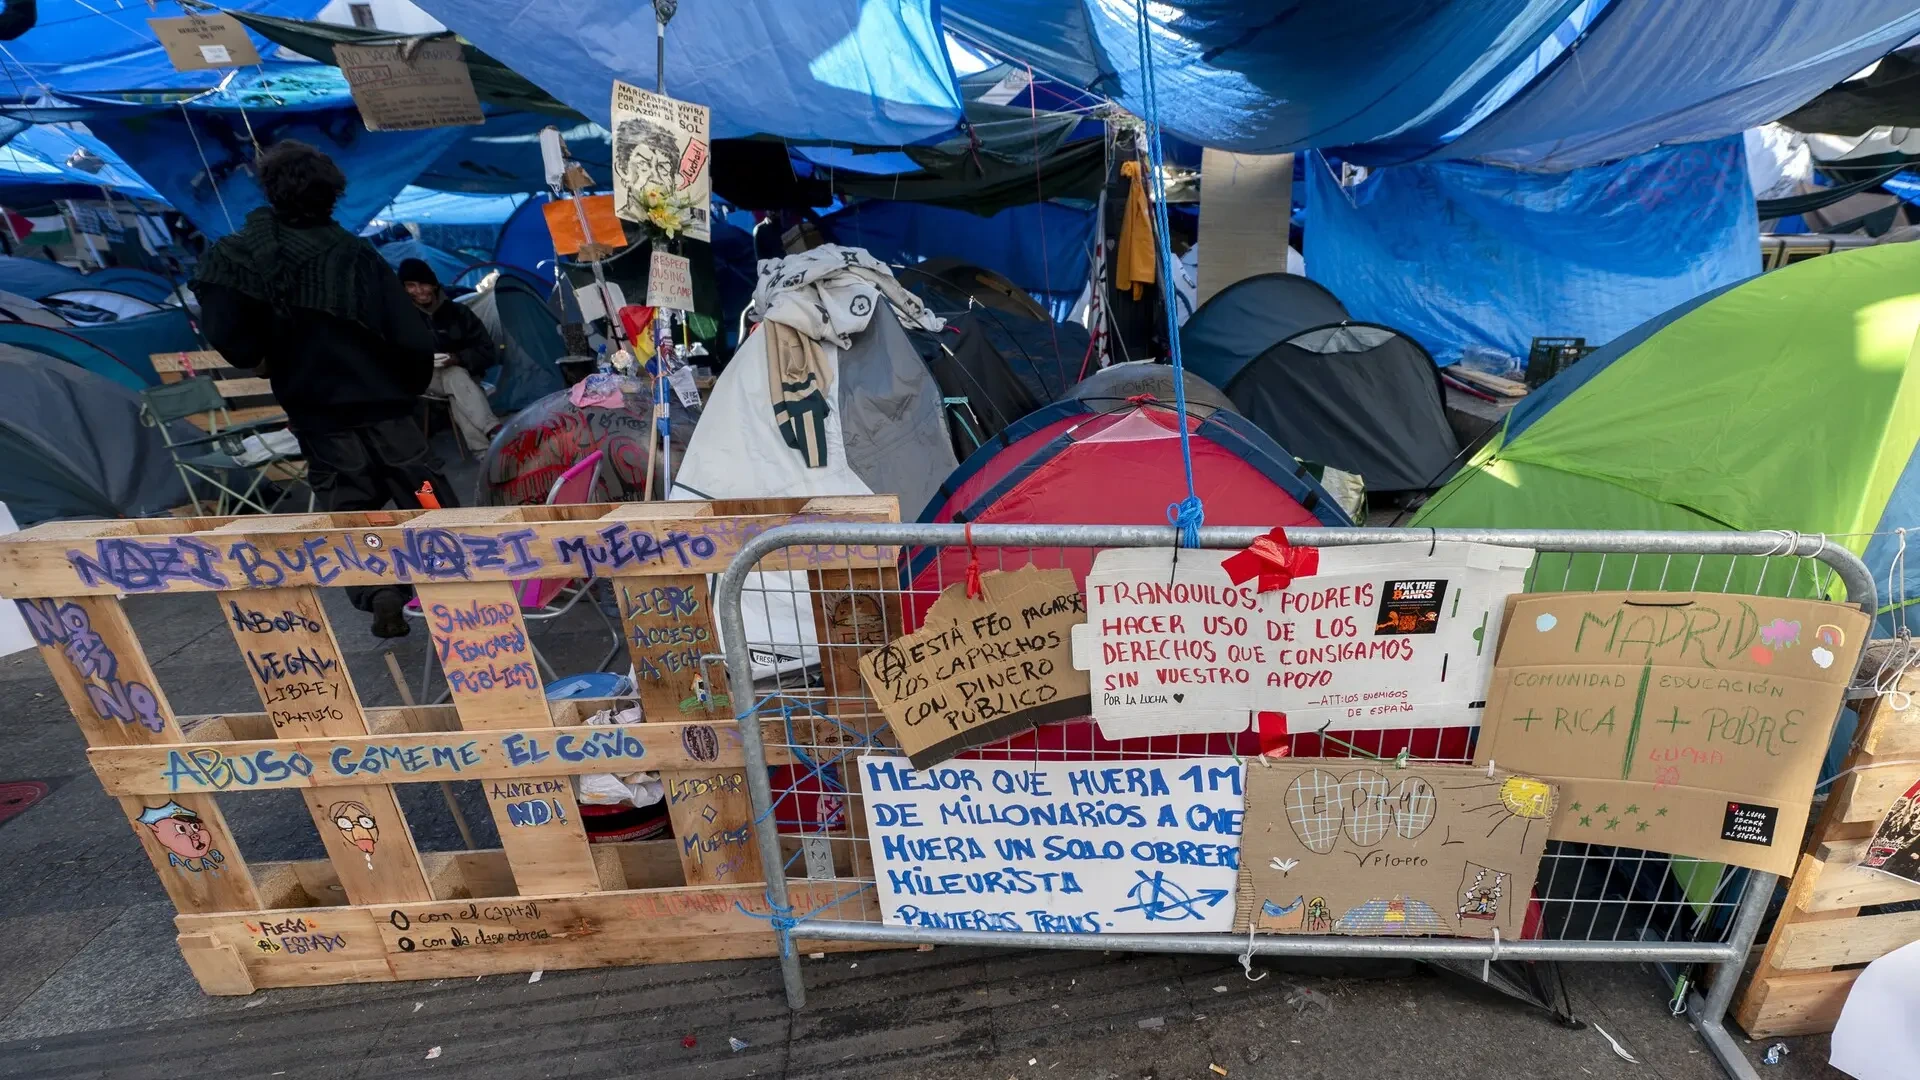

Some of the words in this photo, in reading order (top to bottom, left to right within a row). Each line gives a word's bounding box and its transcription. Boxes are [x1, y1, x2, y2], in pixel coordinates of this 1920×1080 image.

[618, 92, 634, 104] POR
[678, 112, 690, 121] EN
[693, 116, 704, 125] EL
[679, 120, 702, 134] SOL
[652, 268, 685, 283] OUSING
[653, 255, 689, 271] RESPECT
[67, 534, 232, 592] NAZI
[229, 534, 390, 588] BUENO
[390, 527, 542, 581] NAZI
[555, 522, 718, 578] MUERTO
[1281, 582, 1375, 614] PODREIS
[1394, 582, 1415, 590] FAK
[1415, 581, 1436, 590] THE
[229, 600, 320, 633] ABORTO
[432, 600, 514, 633] SANIDAD
[622, 585, 700, 622] LIBRE
[629, 624, 709, 649] ACCESO
[908, 617, 967, 664] ESTÁ
[973, 612, 1012, 639] FEO
[1102, 614, 1186, 637] HACER
[1203, 615, 1248, 637] USO
[1267, 620, 1295, 642] DE
[1315, 615, 1358, 640] LOS
[1575, 601, 1760, 670] MADRID
[1102, 638, 1217, 666] DERECHOS
[1227, 643, 1267, 664] QUE
[1280, 637, 1415, 665] CONSIGAMOS
[638, 656, 661, 680] A
[894, 673, 929, 703] LOS
[936, 630, 1061, 681] CAPRICHOS
[1104, 671, 1140, 691] SIN
[1156, 668, 1250, 685] VUESTRO
[1267, 669, 1334, 689] APOYO
[264, 681, 328, 704] LIBRE
[330, 683, 339, 700] Y
[905, 695, 948, 727] CON
[956, 658, 1054, 701] DINERO
[1139, 693, 1168, 705] LUCHA
[1363, 690, 1408, 700] ENEMIGOS
[1513, 671, 1627, 690] COMUNIDAD
[1659, 673, 1785, 699] EDUCACIÓN
[272, 706, 344, 728] GRATUITO
[943, 684, 1058, 731] PÚBLICO
[1347, 708, 1362, 718] DE
[1370, 702, 1413, 716] ESPAÑA
[1554, 705, 1616, 736] RICA
[1702, 705, 1806, 757] POBRE
[502, 731, 550, 767] EL
[556, 728, 647, 763] COÑO
[866, 762, 983, 792] MEJOR
[991, 769, 1052, 797] QUE
[1069, 768, 1170, 797] MUERA
[1178, 765, 1243, 797] 1M
[873, 802, 924, 827] DE
[1157, 804, 1179, 827] A
[1185, 803, 1244, 836] QUE
[168, 849, 225, 872] ACAB
[882, 834, 986, 863] MUERA
[994, 837, 1036, 861] UN
[1044, 835, 1125, 862] SOLO
[418, 912, 453, 924] con
[460, 903, 480, 920] el
[484, 902, 542, 924] capital
[259, 918, 308, 938] FUEGO
[422, 937, 447, 948] con
[475, 929, 504, 946] clase
[507, 929, 549, 943] obrera
[280, 933, 347, 955] ESTADO
